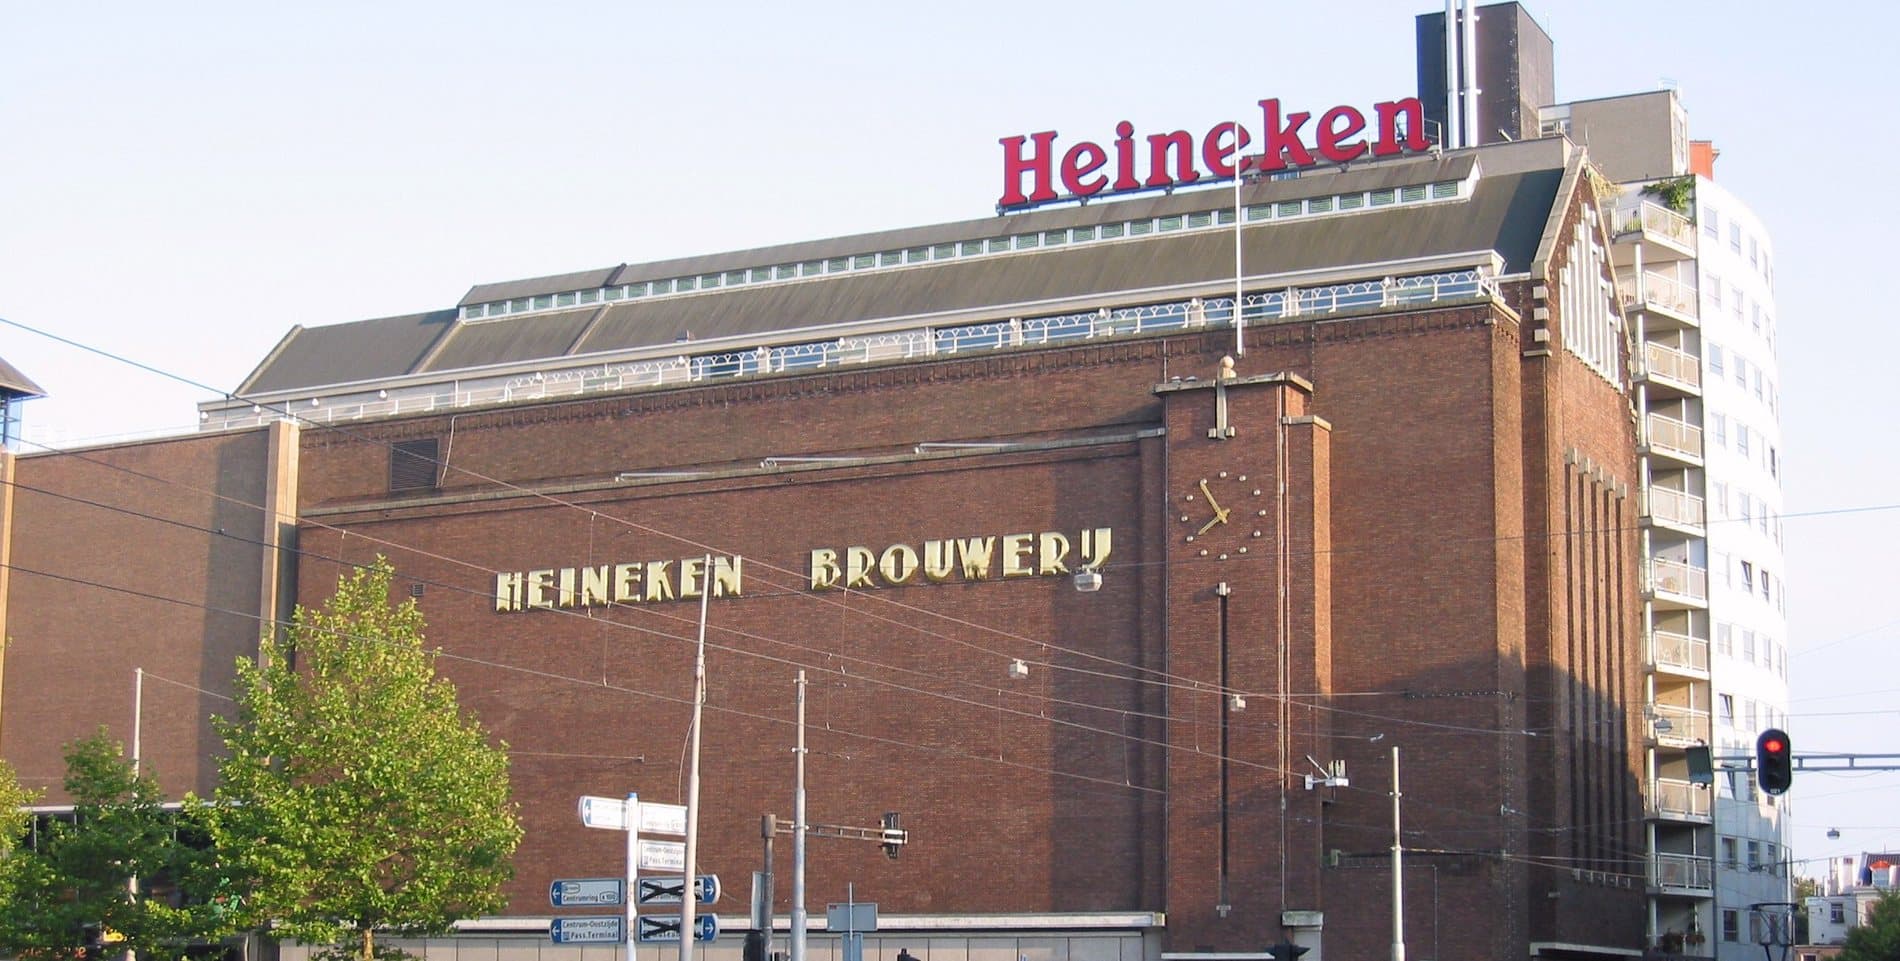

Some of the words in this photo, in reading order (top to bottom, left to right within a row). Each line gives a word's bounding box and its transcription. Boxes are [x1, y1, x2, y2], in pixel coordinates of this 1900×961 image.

[999, 97, 1431, 205] Heineken
[496, 555, 743, 611] HEINEKEN
[811, 528, 1113, 590] BROUWERIJ
